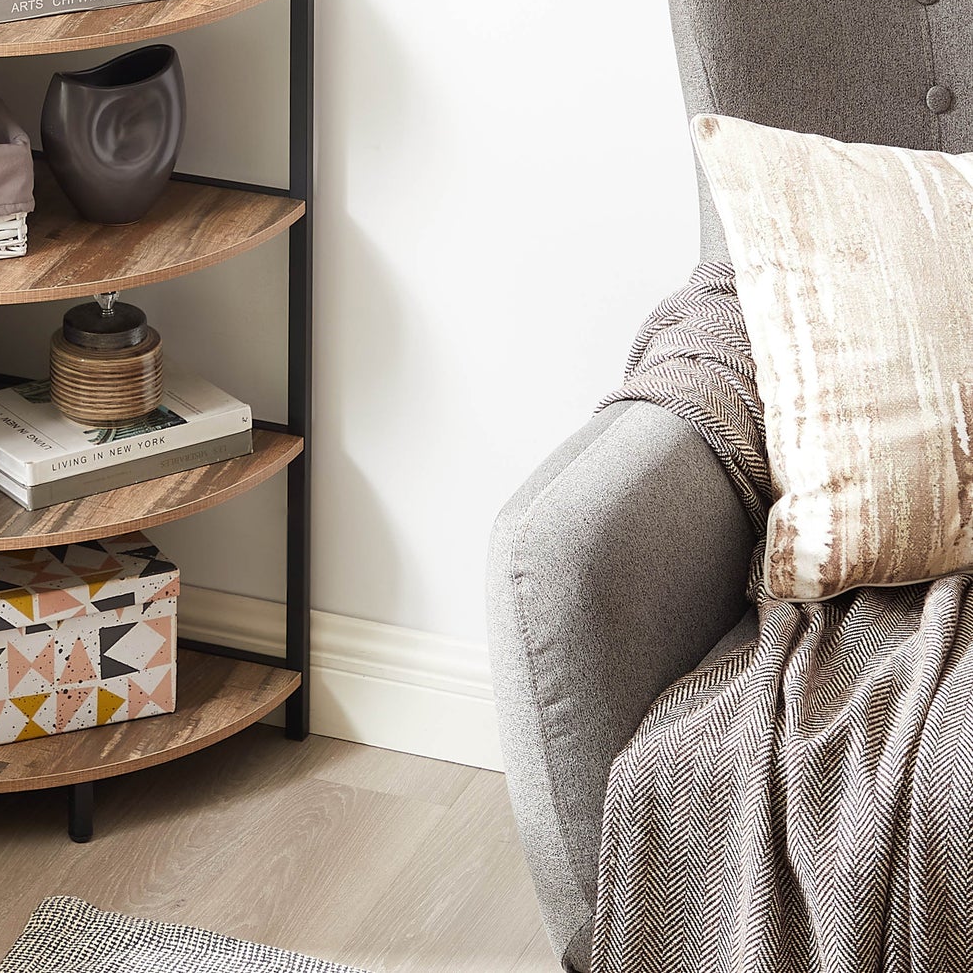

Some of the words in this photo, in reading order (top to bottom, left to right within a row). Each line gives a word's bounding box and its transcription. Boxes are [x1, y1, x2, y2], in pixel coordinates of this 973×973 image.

[11, 0, 44, 14] ARTS
[26, 434, 53, 451] LIVING
[51, 456, 87, 472] LIVING
[93, 451, 105, 461] IN
[109, 444, 132, 458] NEW
[138, 436, 167, 450] YORK
